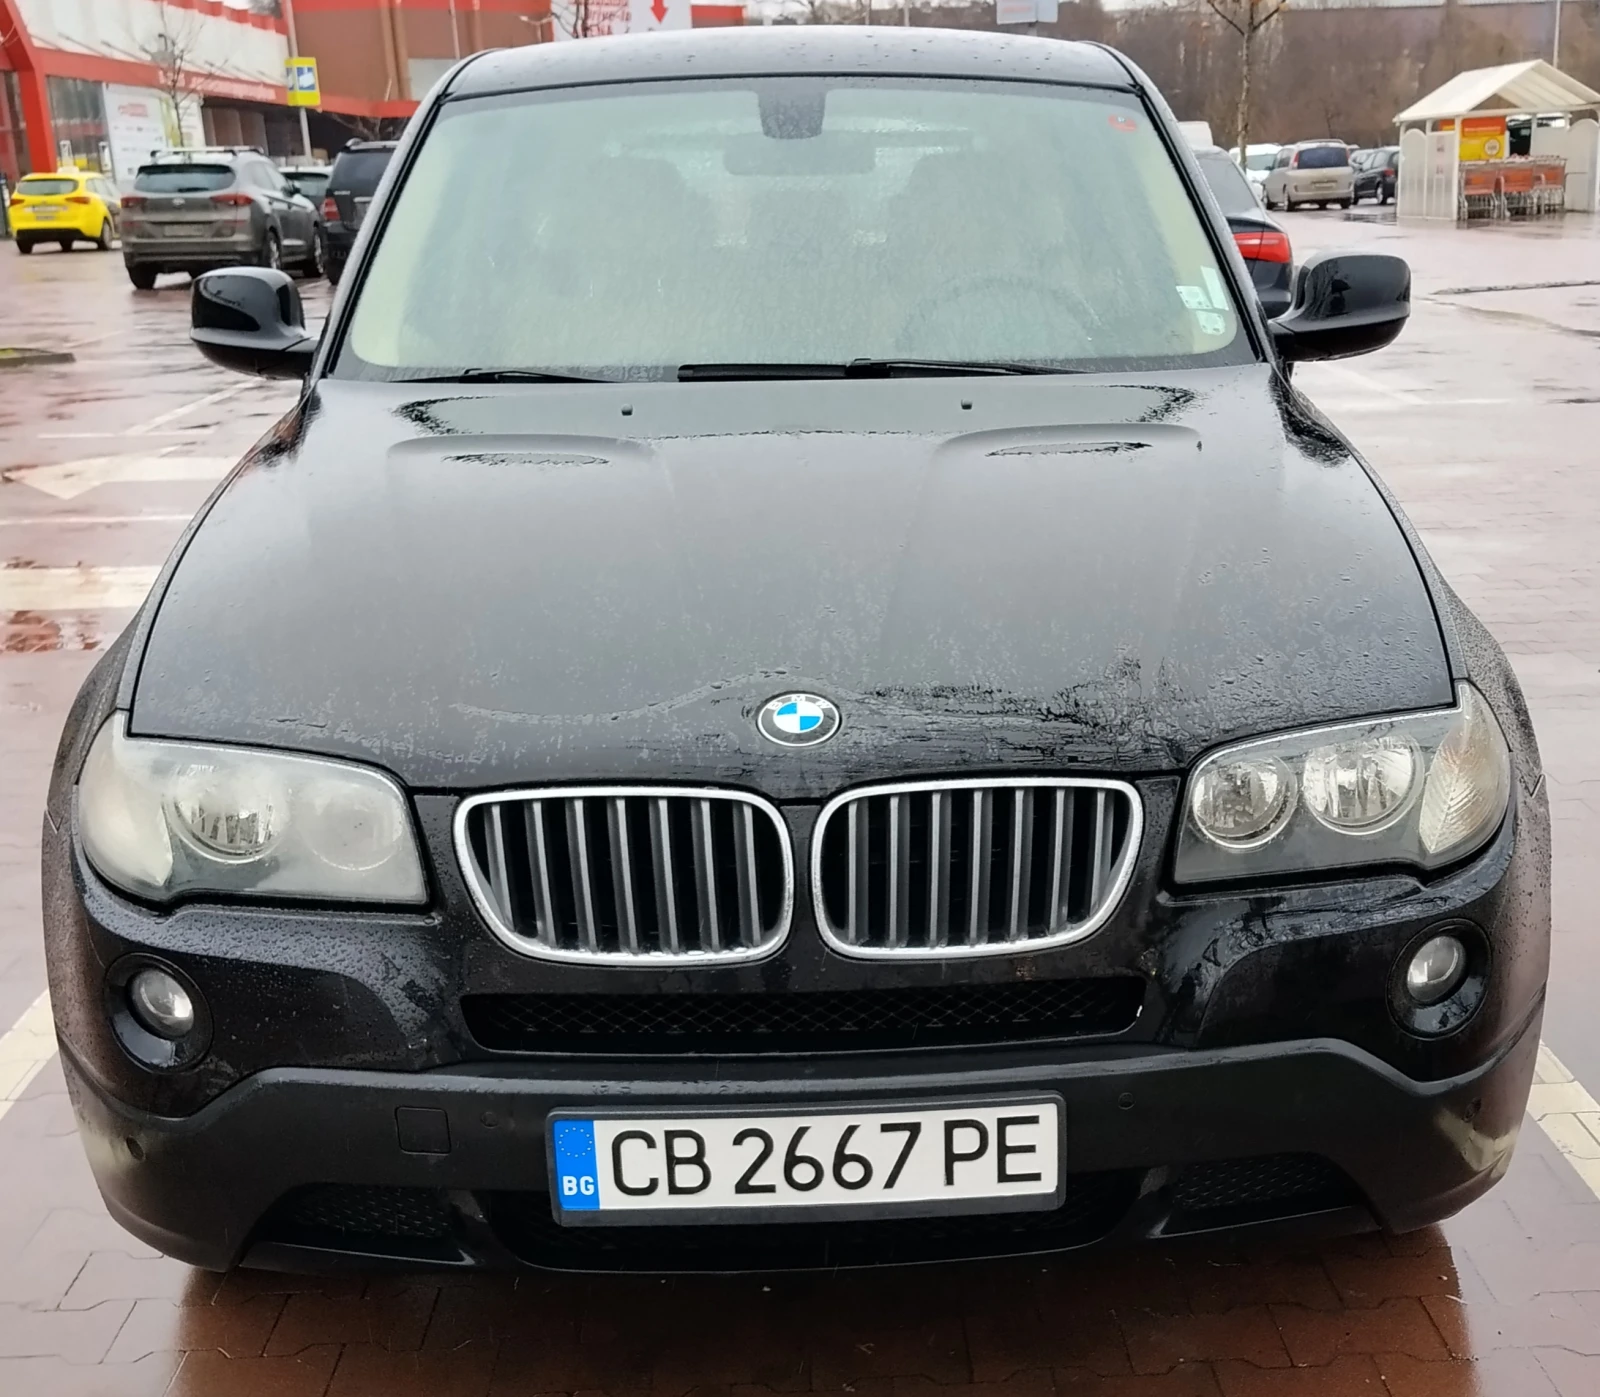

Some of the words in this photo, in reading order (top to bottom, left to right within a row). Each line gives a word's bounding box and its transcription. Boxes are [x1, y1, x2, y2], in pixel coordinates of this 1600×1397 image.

[611, 1128, 712, 1196] CB
[732, 1122, 923, 1194] 2667
[943, 1115, 1043, 1187] PE
[563, 1175, 595, 1196] BG
